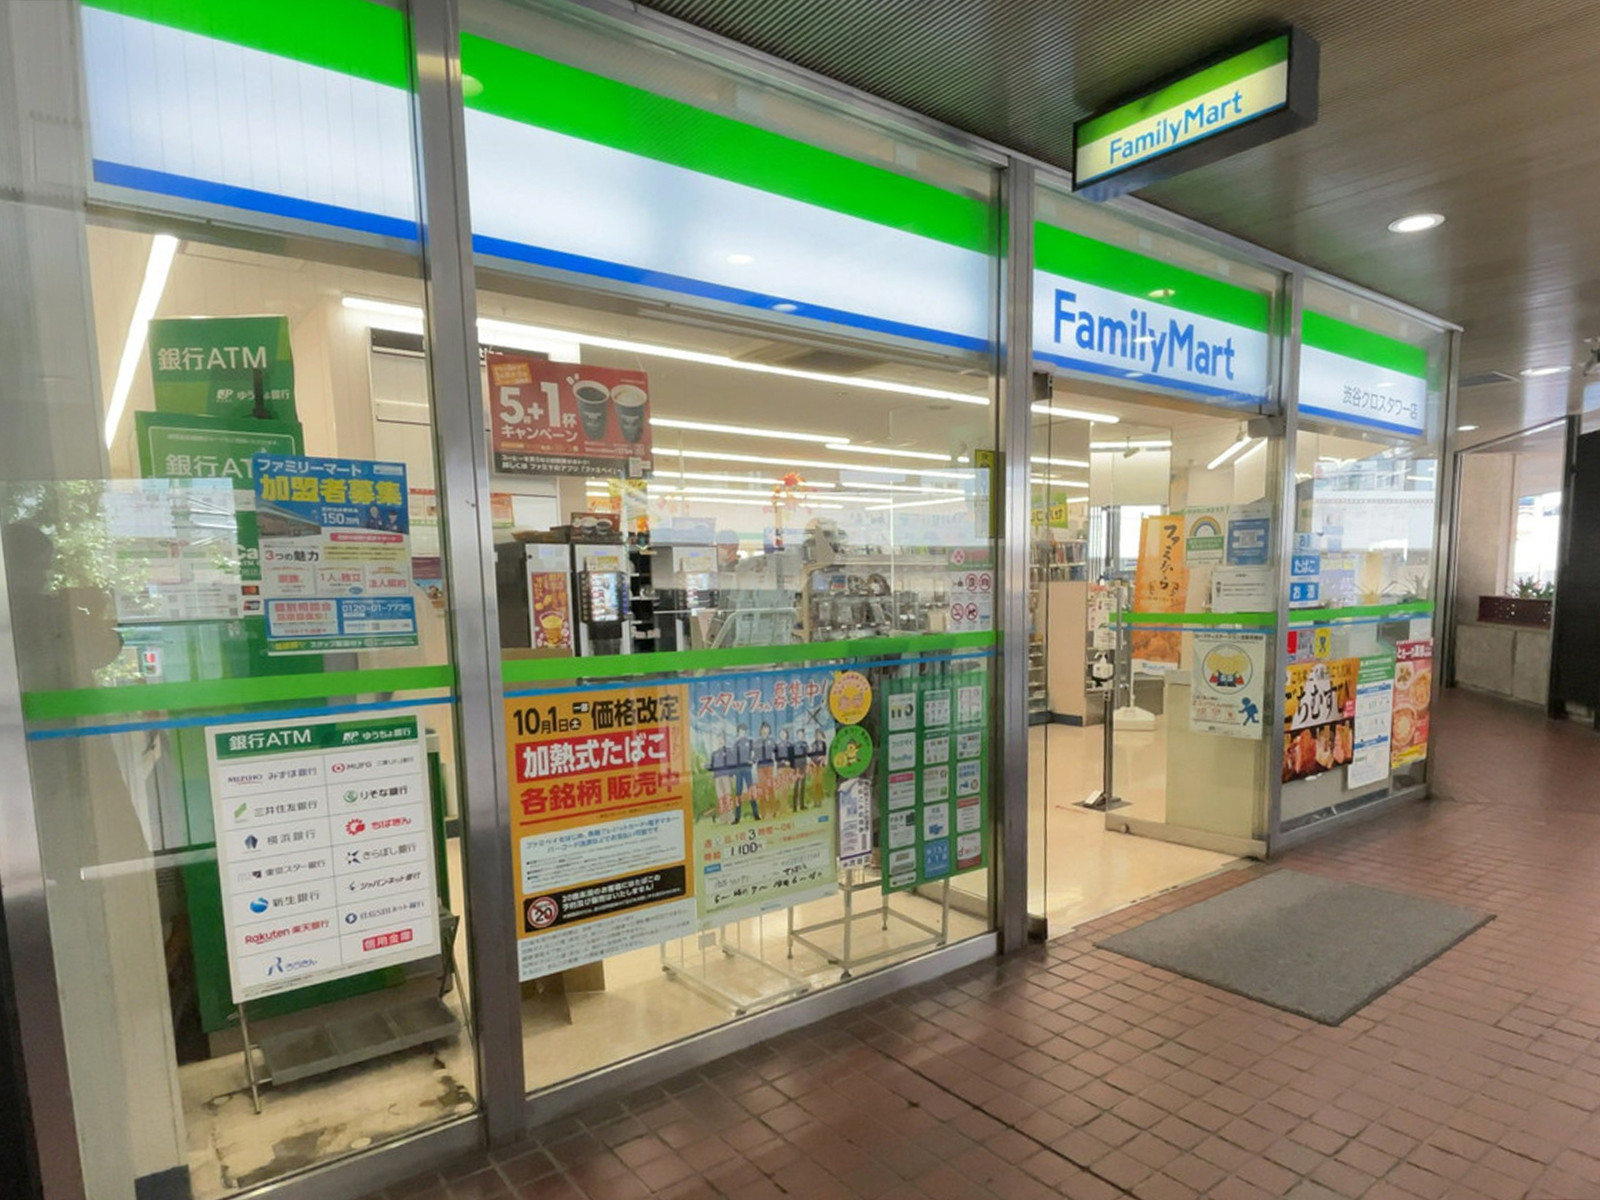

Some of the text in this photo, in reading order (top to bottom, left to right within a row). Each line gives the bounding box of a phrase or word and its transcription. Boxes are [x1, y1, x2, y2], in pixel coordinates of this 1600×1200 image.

[1109, 91, 1243, 164] FamilyMart
[1053, 288, 1235, 380] FamilyMart
[157, 346, 267, 371] 銀行ATM
[1342, 385, 1418, 420] 渋谷クロスタワー店
[501, 424, 578, 442] キャンペーン
[165, 453, 254, 480] 銀行AT
[257, 458, 362, 477] ファミリーマート
[260, 474, 402, 505] 加盟者募集
[265, 550, 320, 562] 3つの魅力
[591, 695, 680, 731] 価格改定
[228, 729, 312, 751] 銀行ATM
[362, 727, 412, 741] ゆうちょ銀行
[522, 732, 667, 779] 加熱式たばこ
[267, 767, 317, 780] みずほ銀行
[359, 785, 408, 801] りそな銀行
[520, 767, 680, 816] 各銘柄 販売中
[254, 800, 318, 818] 三井住友銀行
[370, 816, 412, 830] ちばぎん
[266, 829, 316, 846] 横浜銀行
[748, 829, 757, 841] 3
[362, 843, 417, 860] きらぼし銀行
[265, 860, 326, 877] 東京スター銀行
[360, 871, 421, 891] ジャパンネット銀行
[272, 892, 320, 908] 新生銀行
[244, 919, 330, 944] Rakuten 楽天銀行
[363, 929, 413, 950] 信用金庫
